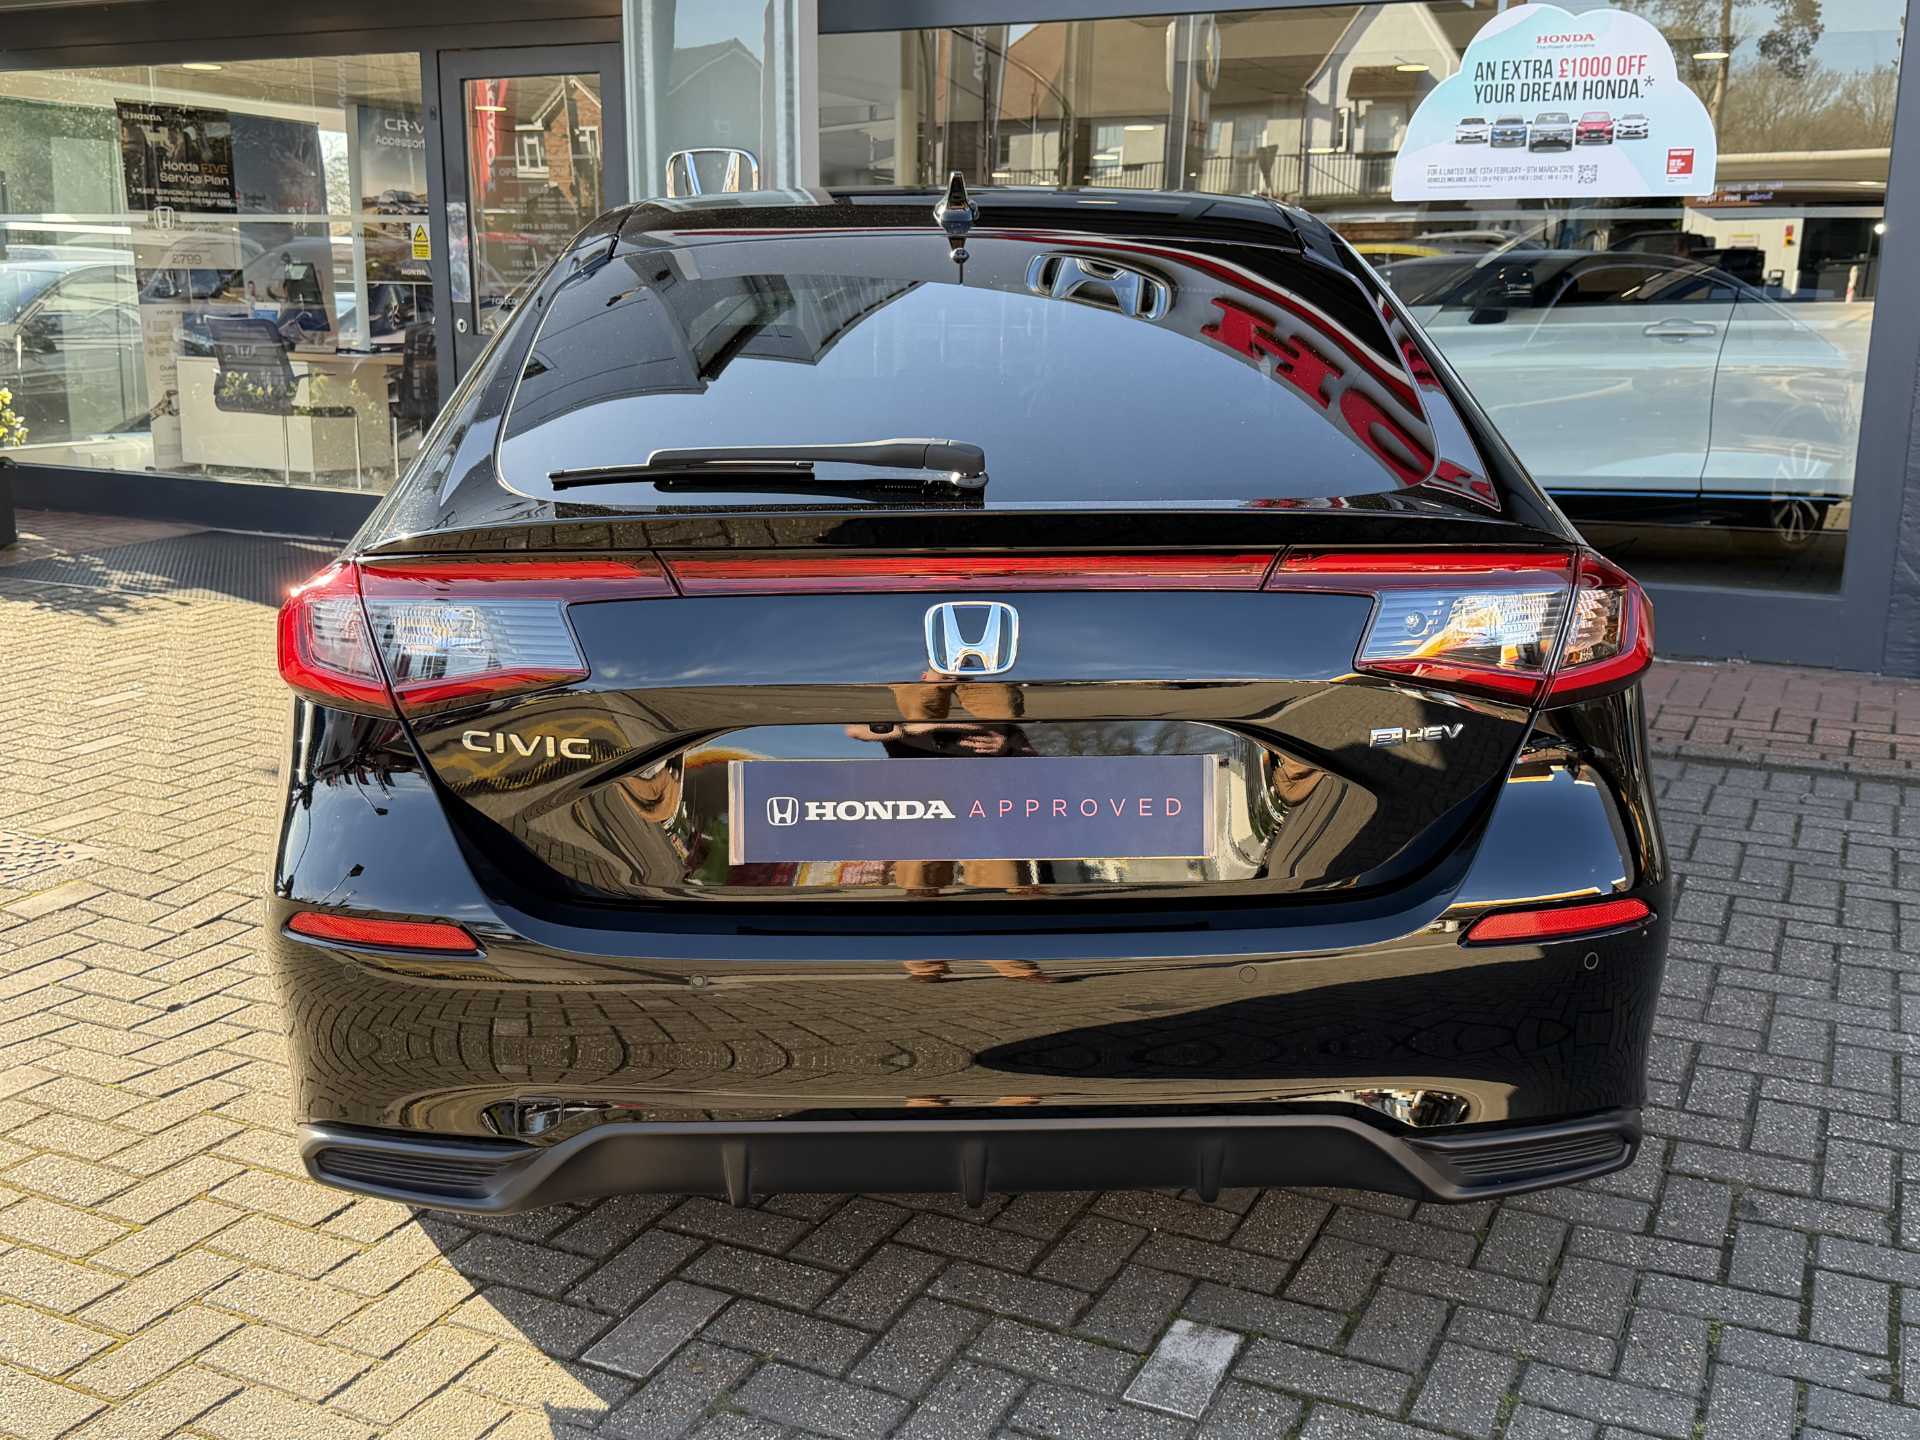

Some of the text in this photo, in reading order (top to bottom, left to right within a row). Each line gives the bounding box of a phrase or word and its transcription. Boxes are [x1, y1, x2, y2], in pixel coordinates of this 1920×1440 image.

[1536, 33, 1596, 44] HONDA
[1474, 54, 1648, 82] AN EXTRA £1000 OFF
[1474, 82, 1516, 105] YOUR
[1520, 80, 1577, 103] DREAM
[160, 172, 230, 186] Service Plan
[162, 160, 229, 175] Honda FIVE
[461, 730, 592, 759] CIVIC
[805, 797, 1183, 820] HONDA APPROVED
